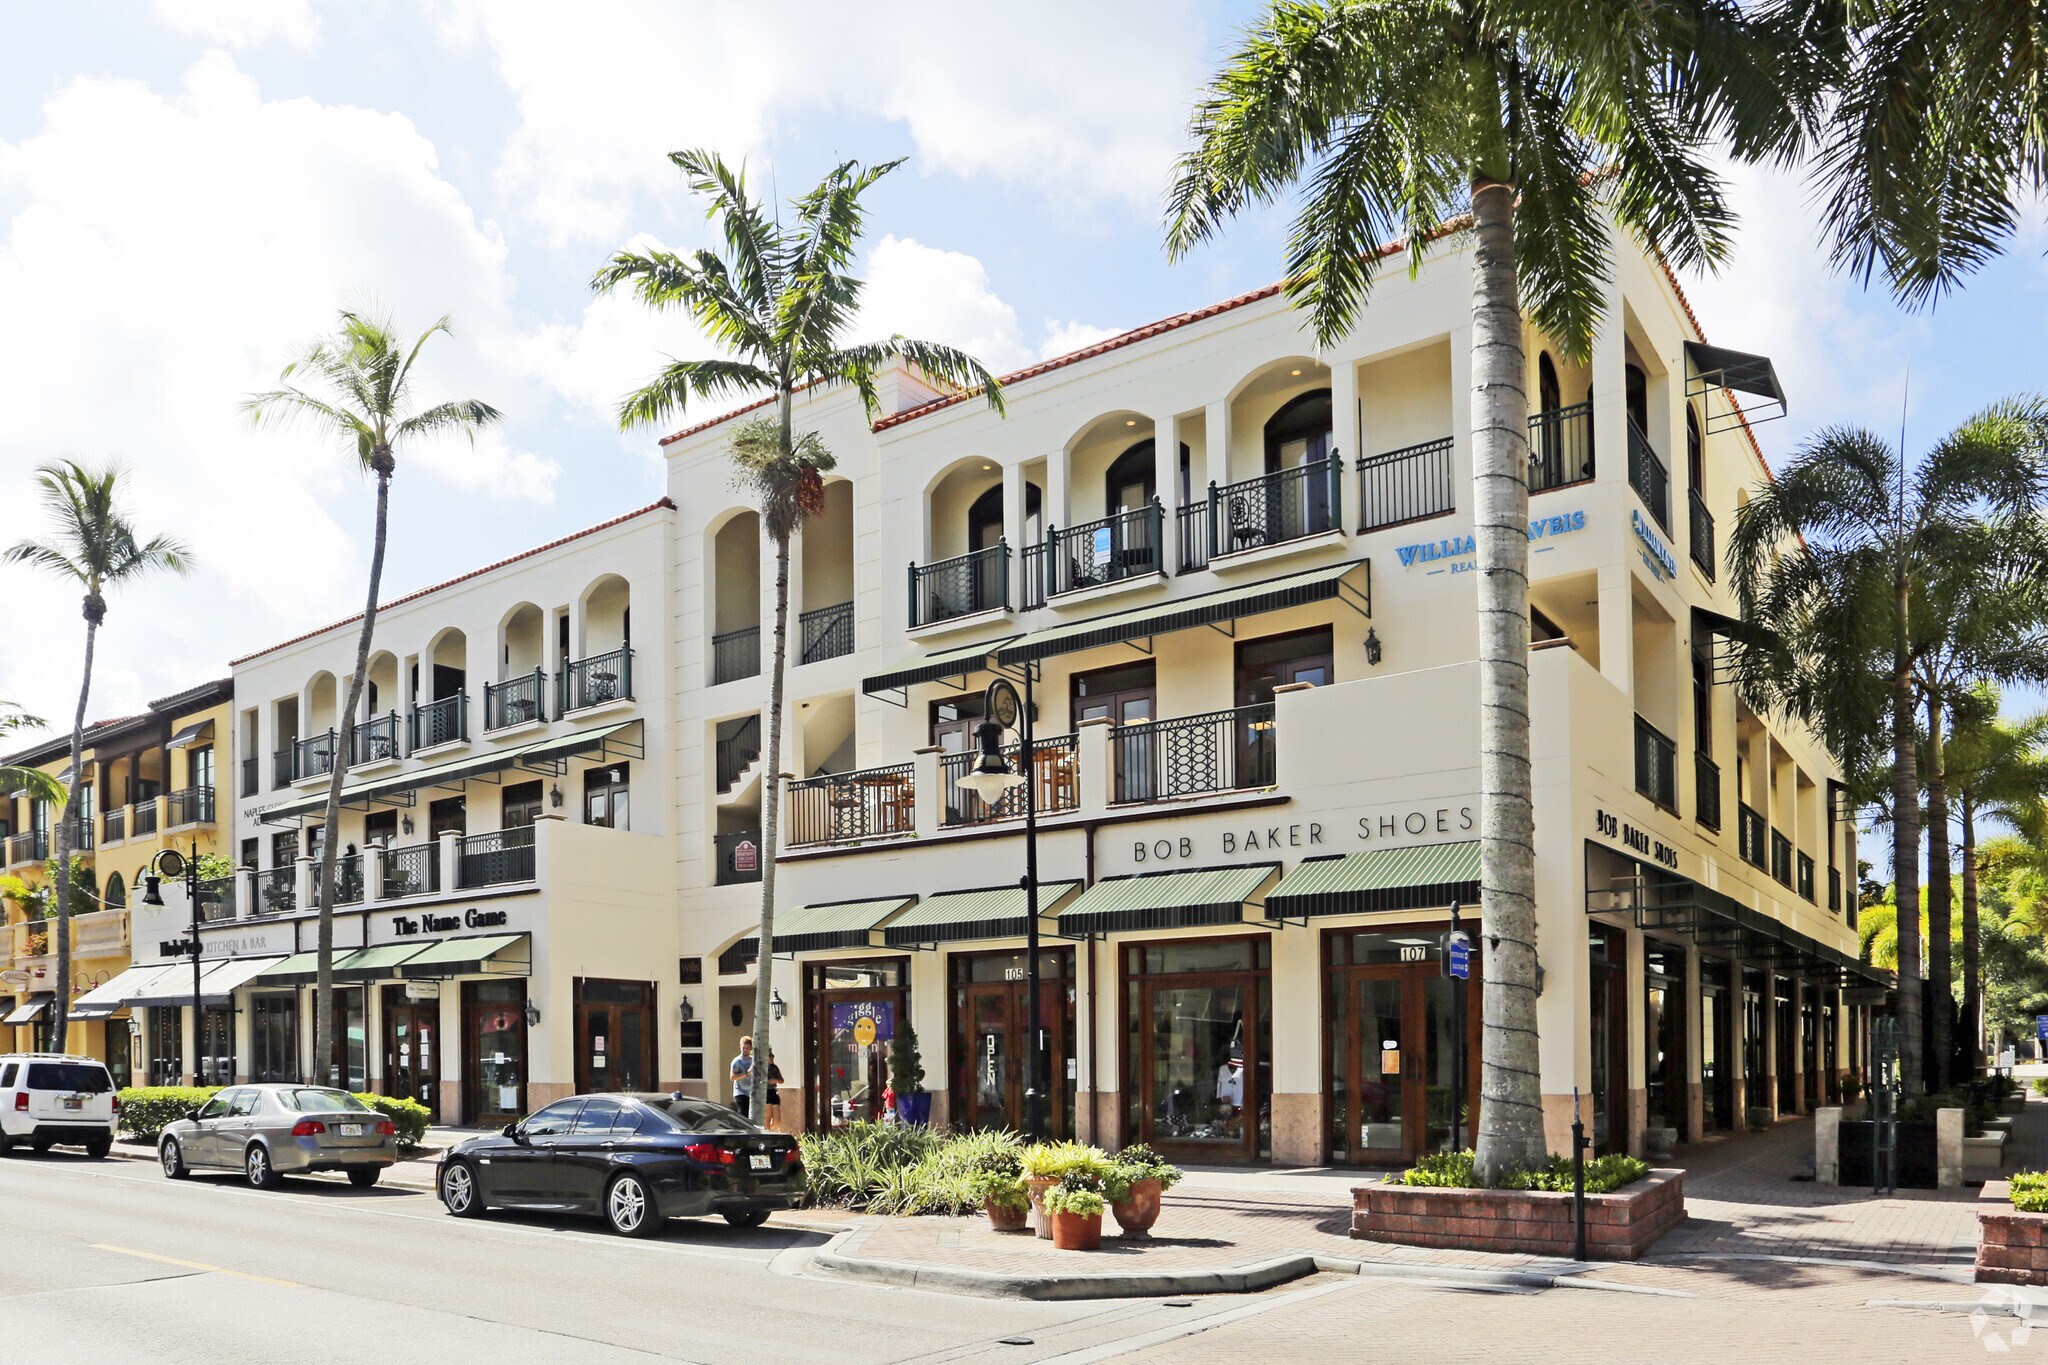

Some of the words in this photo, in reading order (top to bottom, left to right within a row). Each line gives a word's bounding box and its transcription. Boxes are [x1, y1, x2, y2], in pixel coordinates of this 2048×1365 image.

[1395, 534, 1476, 567] WILLIA
[1134, 837, 1192, 862] BOB
[1223, 822, 1322, 854] BAKER
[1358, 807, 1473, 839] SHOES
[1597, 809, 1617, 838] BOB
[1623, 823, 1649, 855] BAKER
[1654, 841, 1678, 869] SHOES
[393, 916, 418, 935] The
[421, 914, 460, 933] Name
[465, 908, 507, 928] Game
[206, 939, 239, 953] KITCHEN
[242, 939, 247, 949] &
[250, 937, 266, 949] BAR
[1403, 947, 1424, 960] 107
[1006, 969, 1023, 980] 105
[847, 1003, 882, 1026] giggle
[986, 1034, 996, 1086] OPEN
